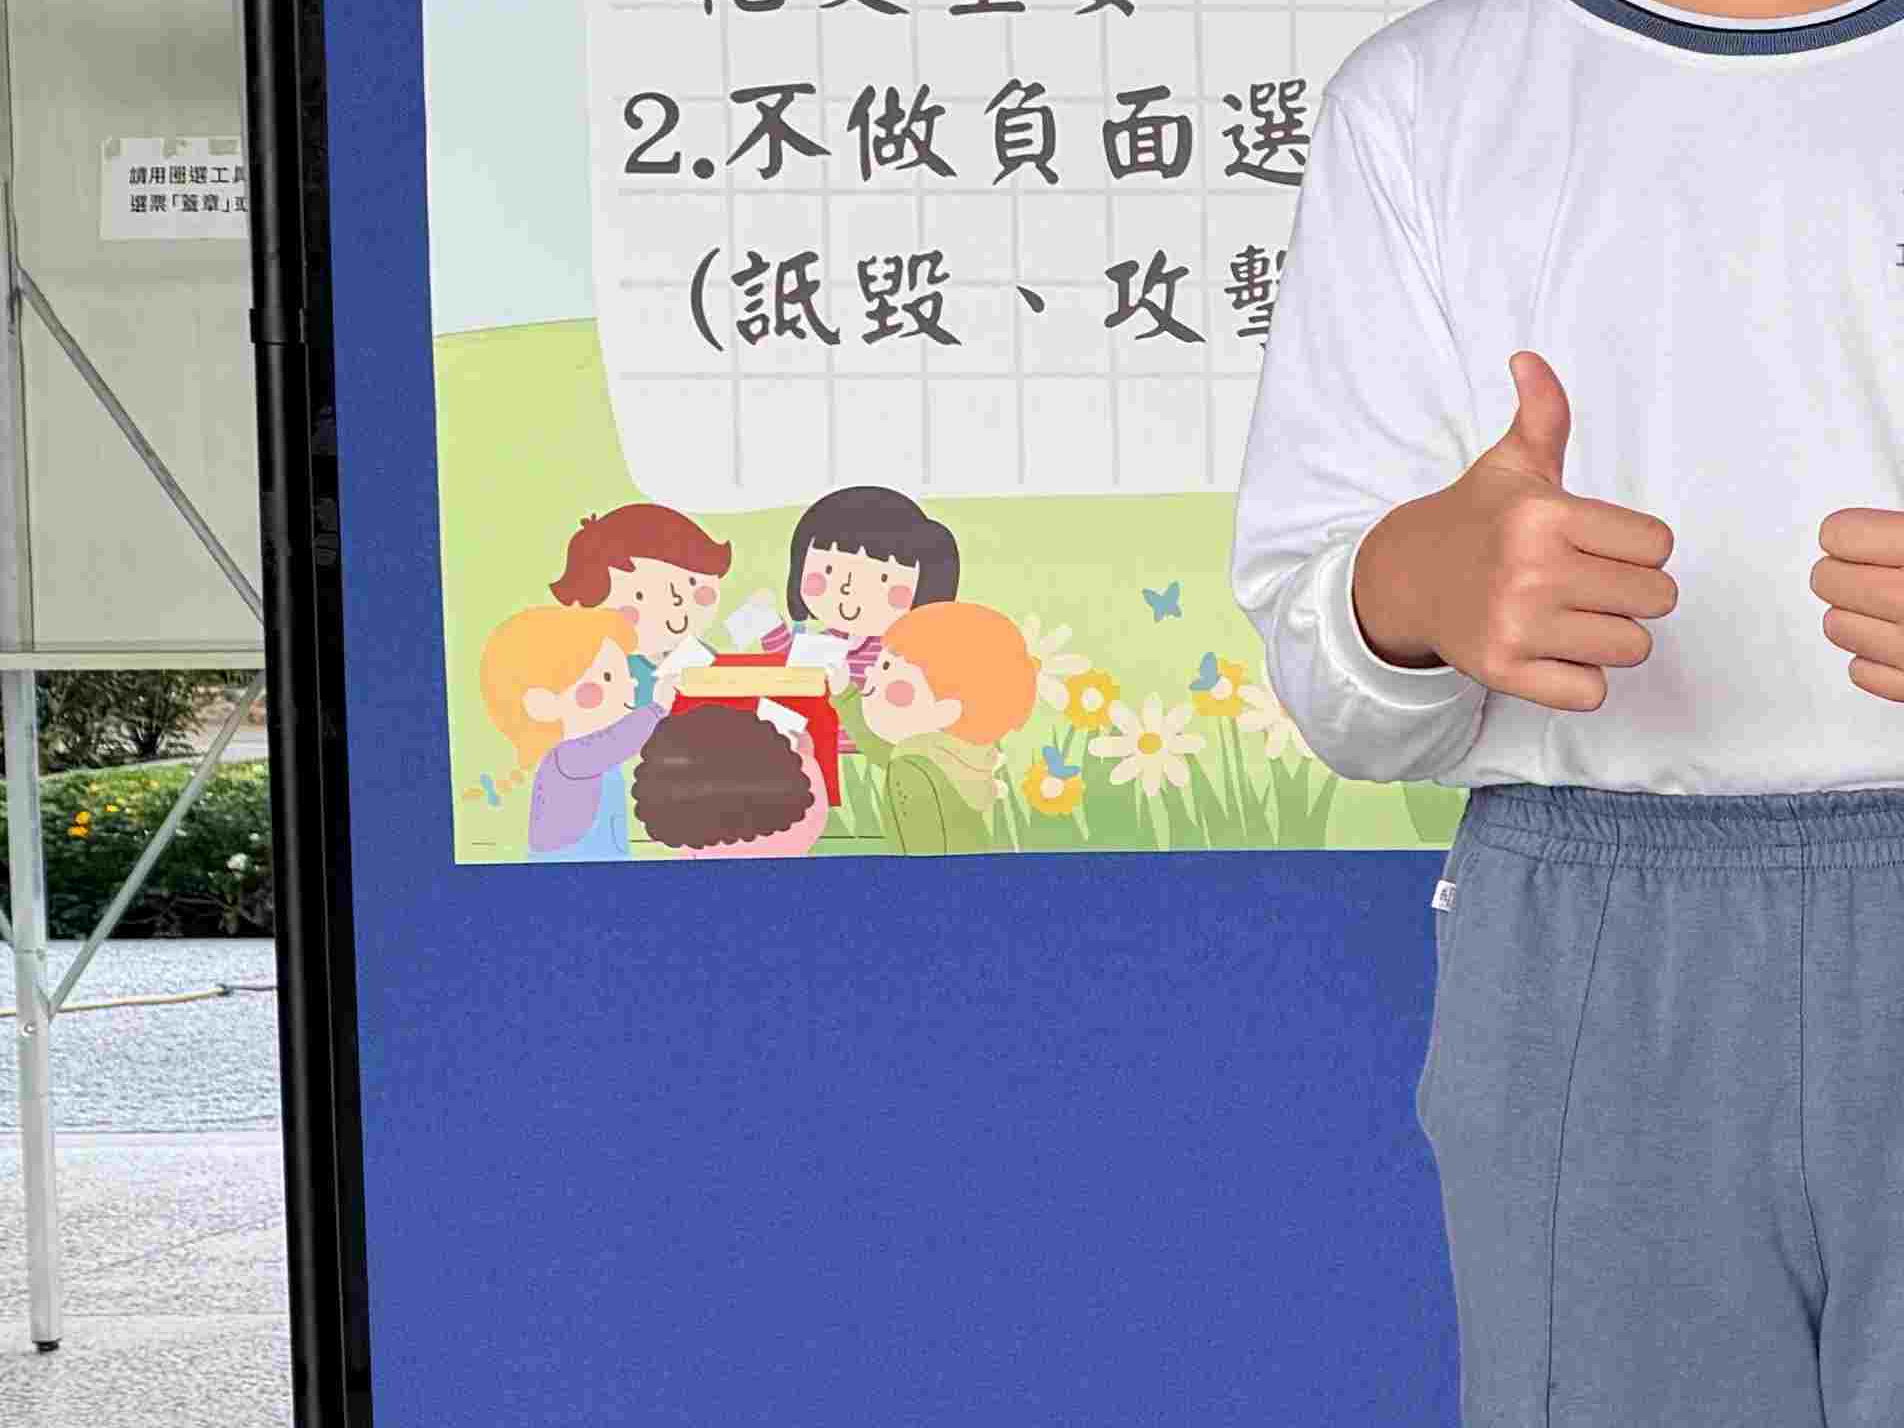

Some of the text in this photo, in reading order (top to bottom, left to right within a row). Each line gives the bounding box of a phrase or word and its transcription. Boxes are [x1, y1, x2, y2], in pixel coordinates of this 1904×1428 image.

[622, 76, 1311, 186] 2.不做負面選
